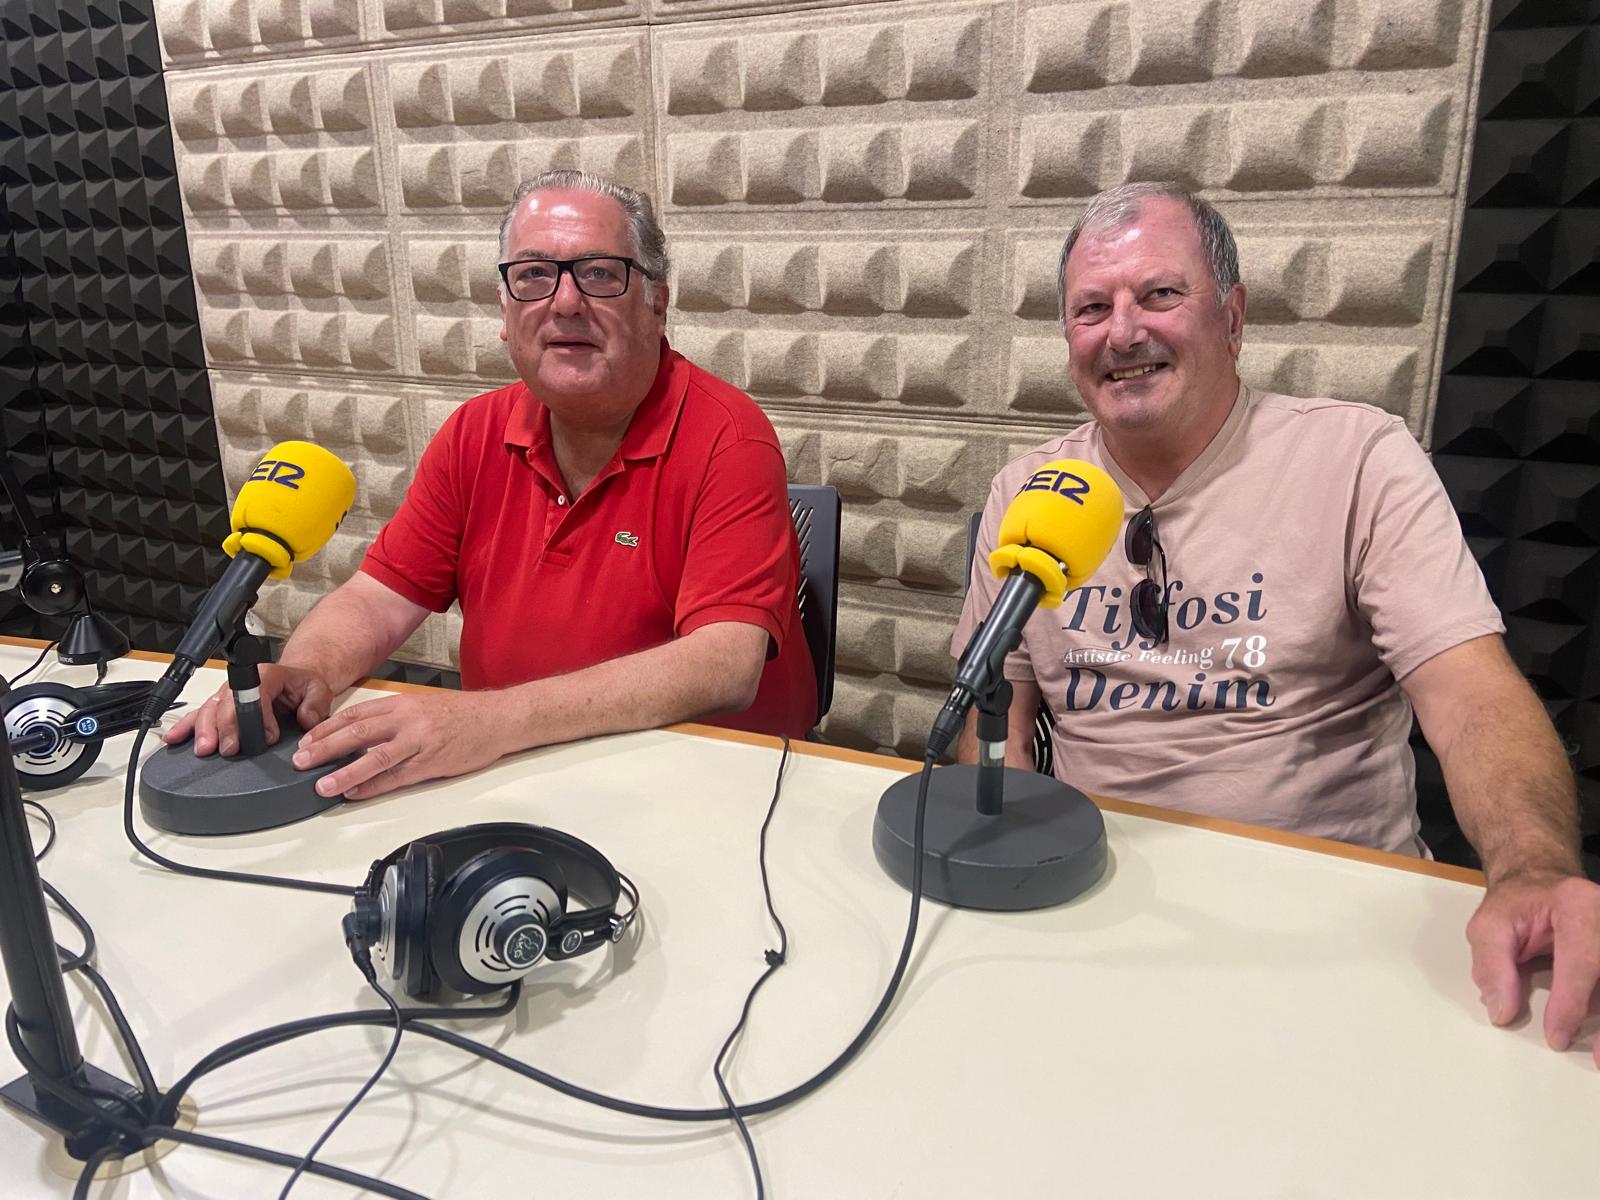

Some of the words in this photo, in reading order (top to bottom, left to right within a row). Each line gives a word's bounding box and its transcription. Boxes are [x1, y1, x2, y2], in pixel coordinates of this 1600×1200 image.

[1015, 470, 1090, 505] ER
[1063, 648, 1133, 664] Artistic
[1138, 647, 1213, 669] Feeling
[1220, 635, 1267, 669] 78
[1065, 666, 1277, 712] Denim
